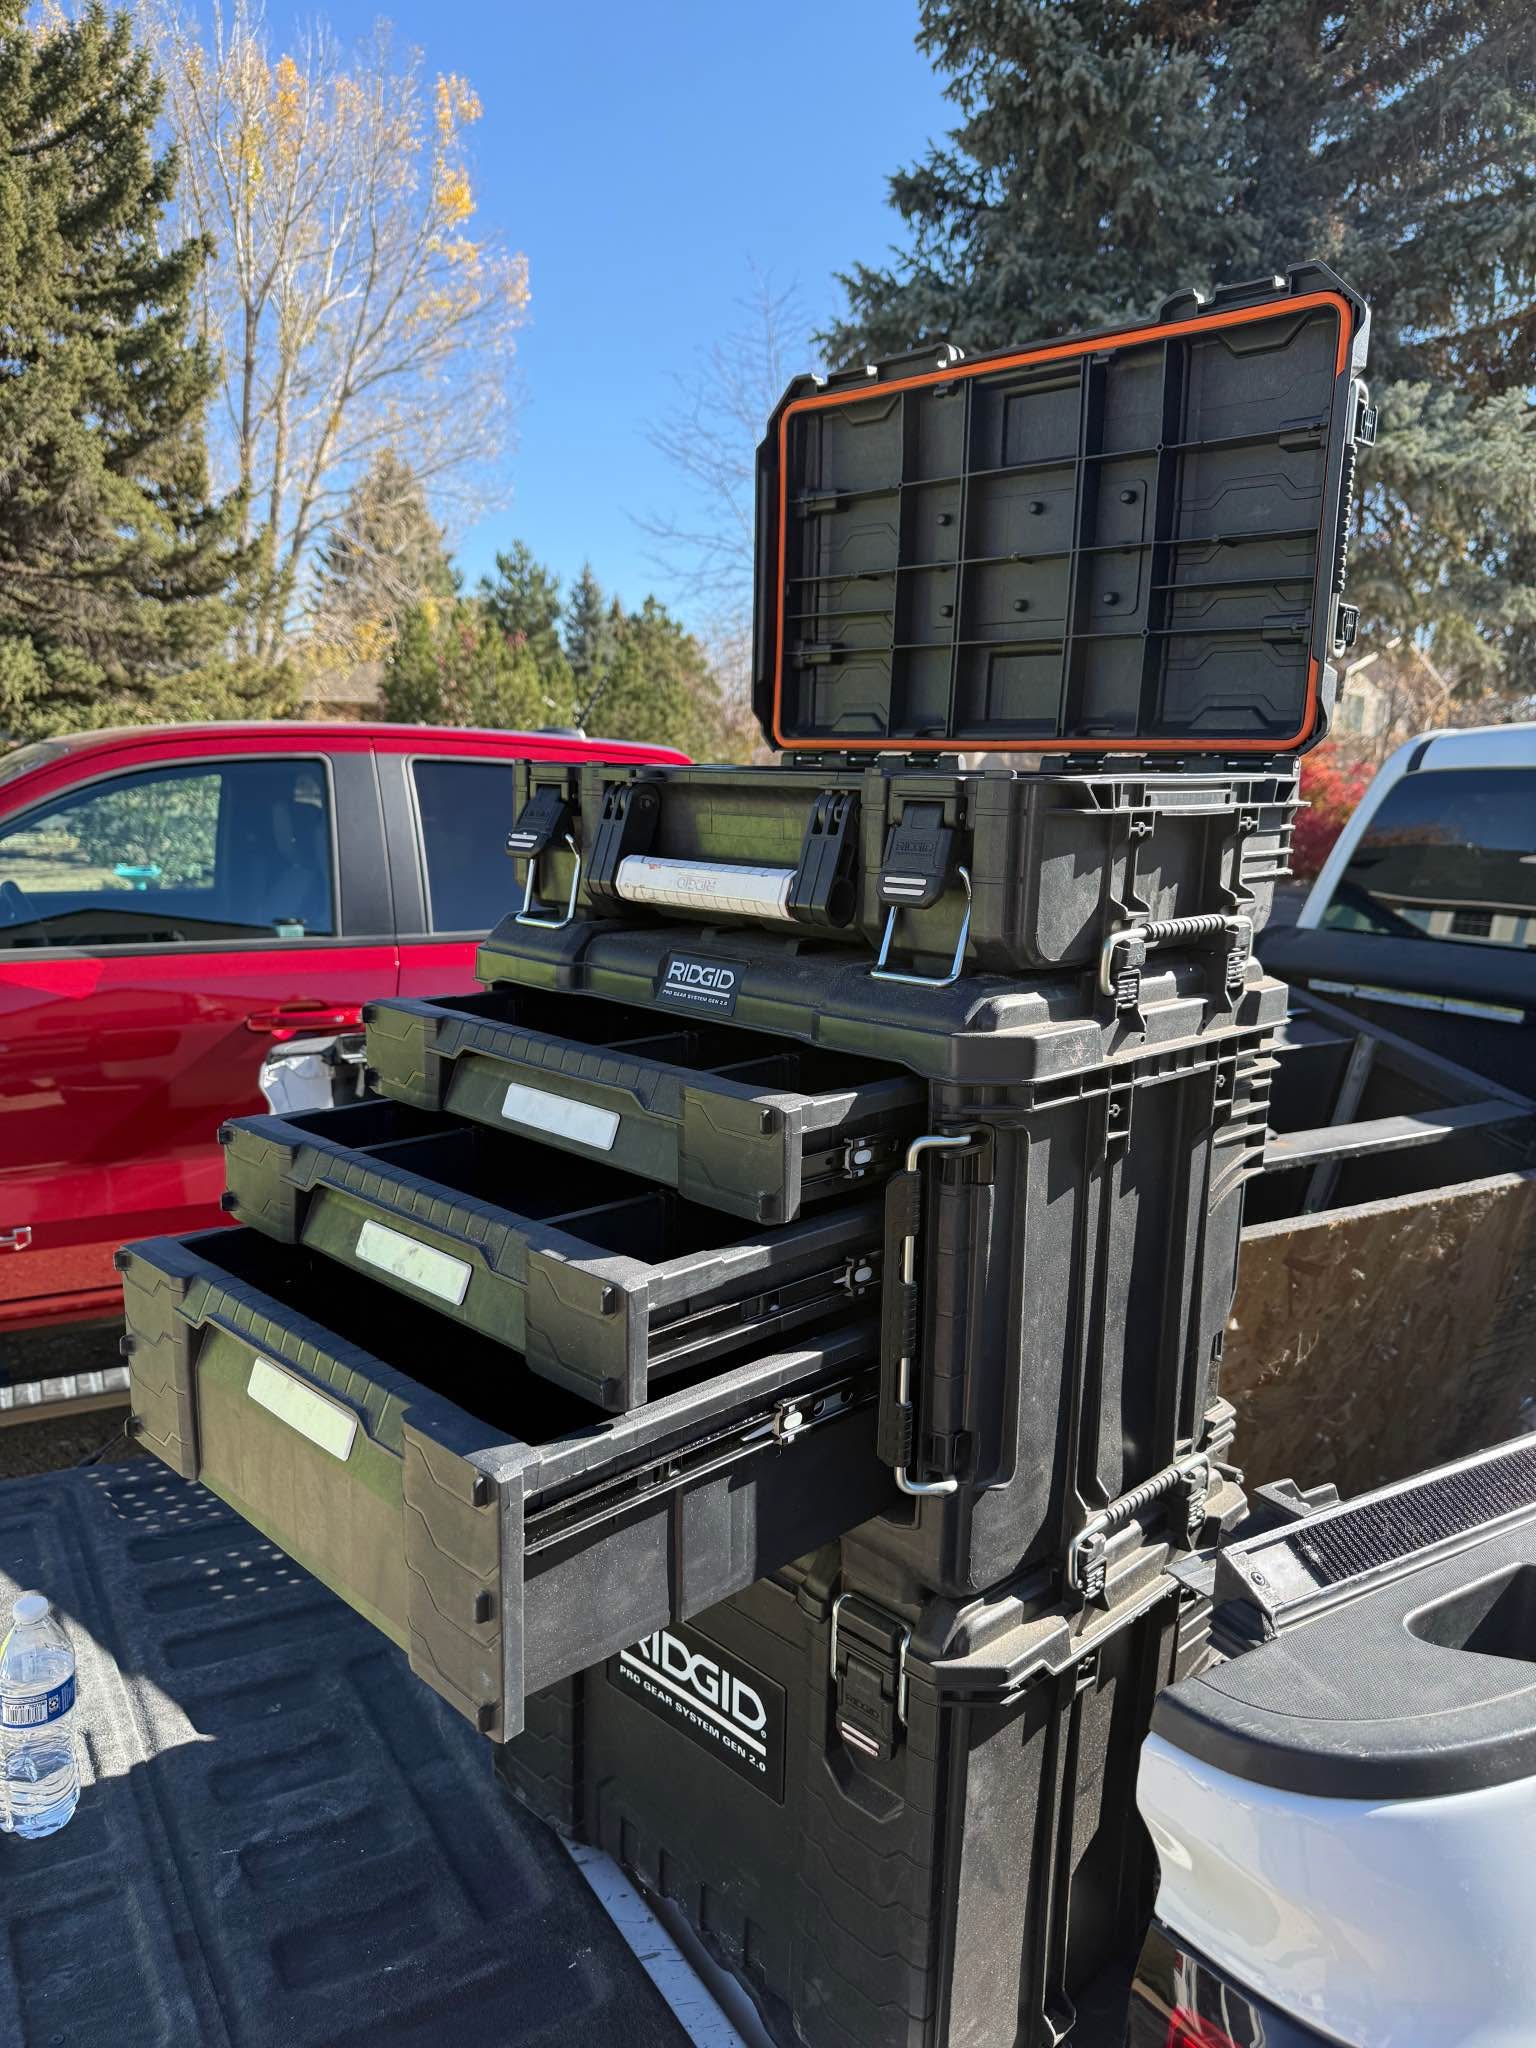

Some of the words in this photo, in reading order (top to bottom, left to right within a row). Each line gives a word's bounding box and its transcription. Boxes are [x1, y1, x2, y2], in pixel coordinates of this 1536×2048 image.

[667, 961, 735, 989] RIDGID
[687, 994, 708, 1002] SYSTEM
[619, 1664, 641, 1684] PRO
[643, 1680, 673, 1706] GEAR
[675, 1702, 720, 1739] SYSTEM
[722, 1735, 746, 1758] GEN
[749, 1754, 766, 1773] 2.0
